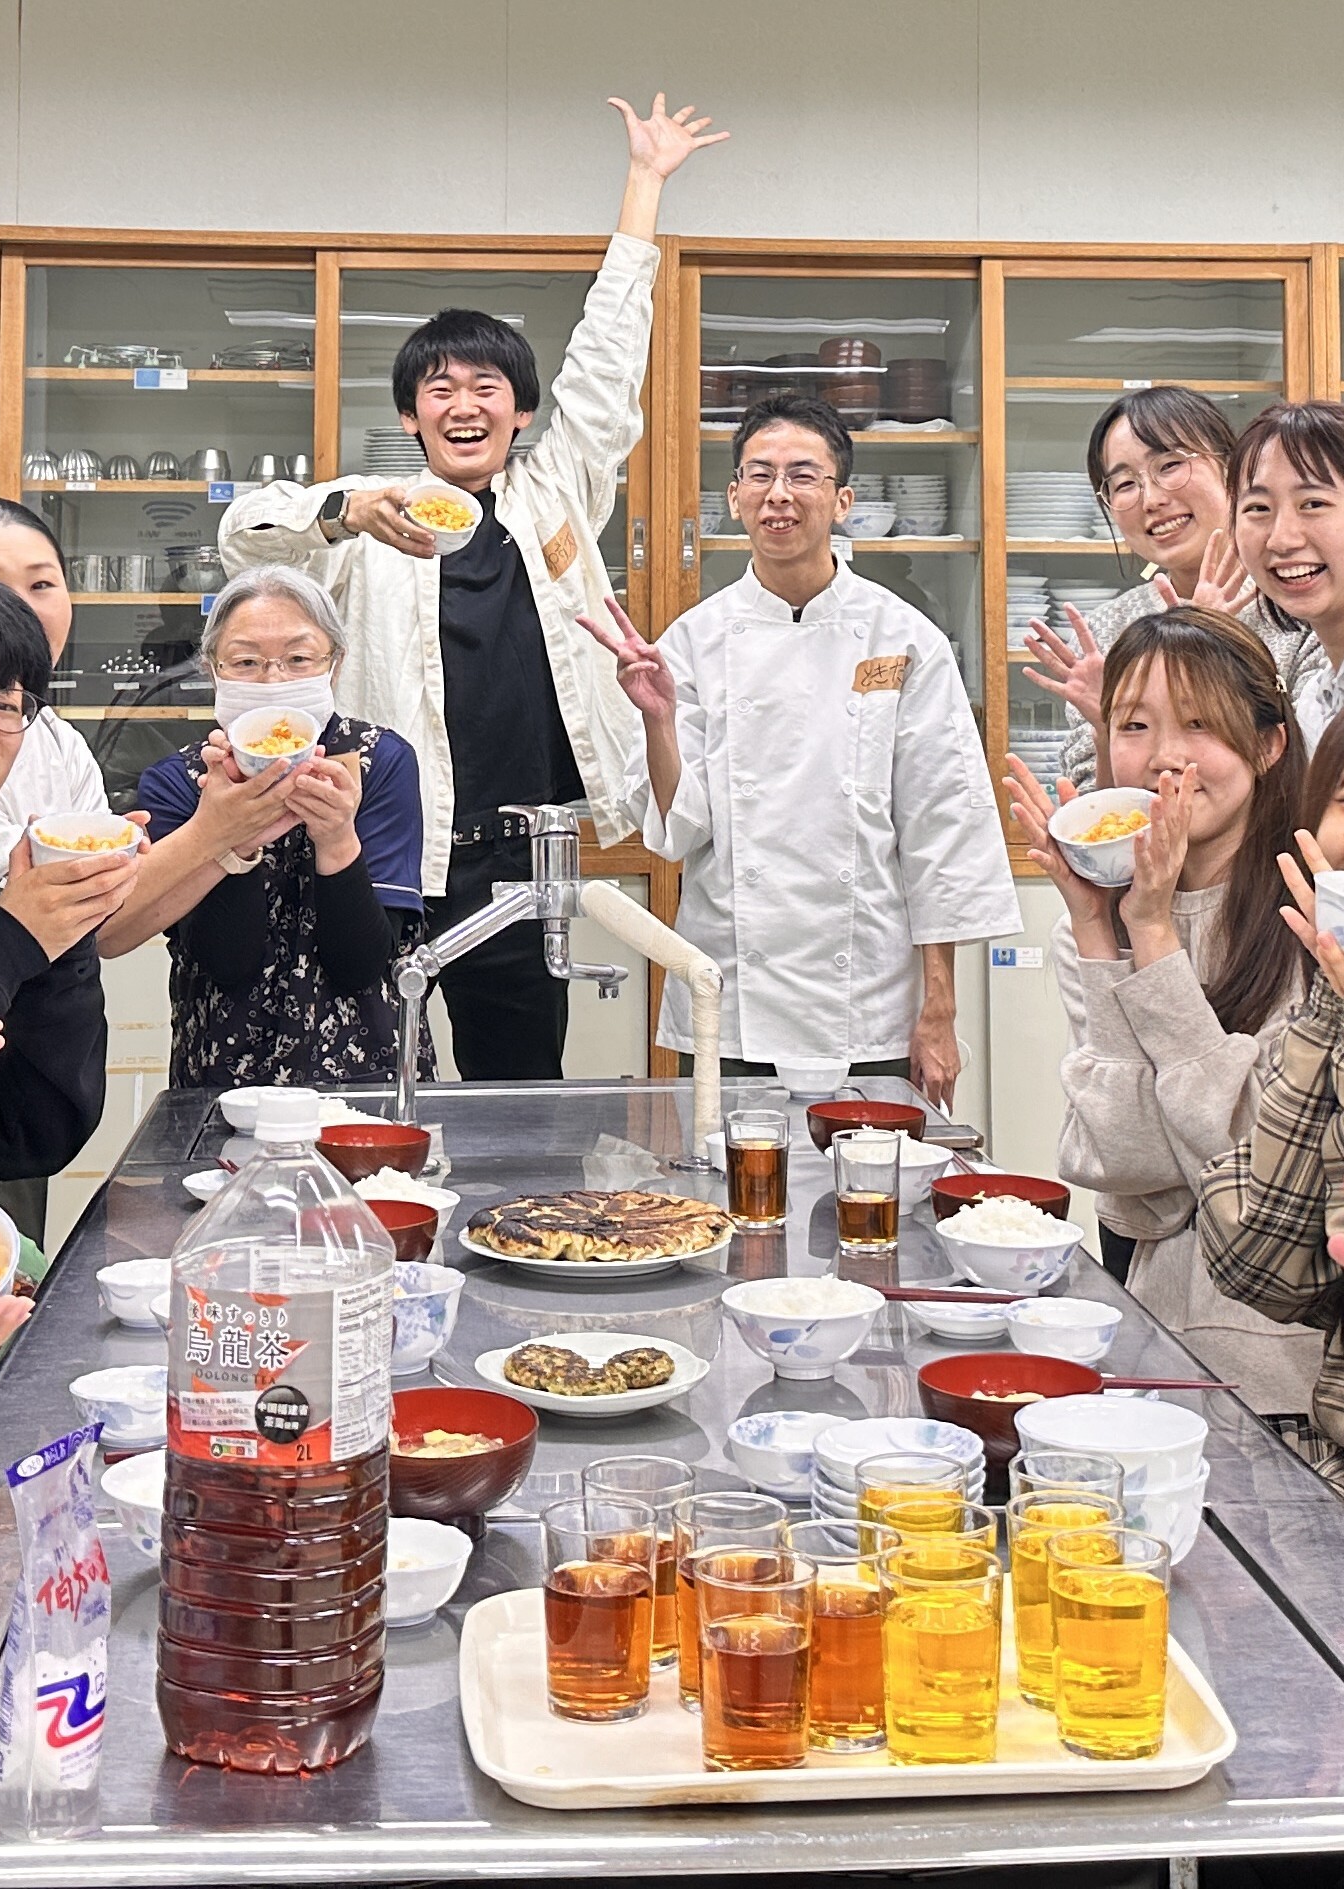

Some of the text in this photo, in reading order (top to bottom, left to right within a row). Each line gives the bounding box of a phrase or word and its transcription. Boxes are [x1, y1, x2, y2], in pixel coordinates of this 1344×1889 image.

[861, 661, 904, 687] ときた
[189, 1302, 287, 1327] 後味すっきり
[194, 1368, 277, 1385] OOLONG TEA
[296, 1444, 313, 1462] 2L
